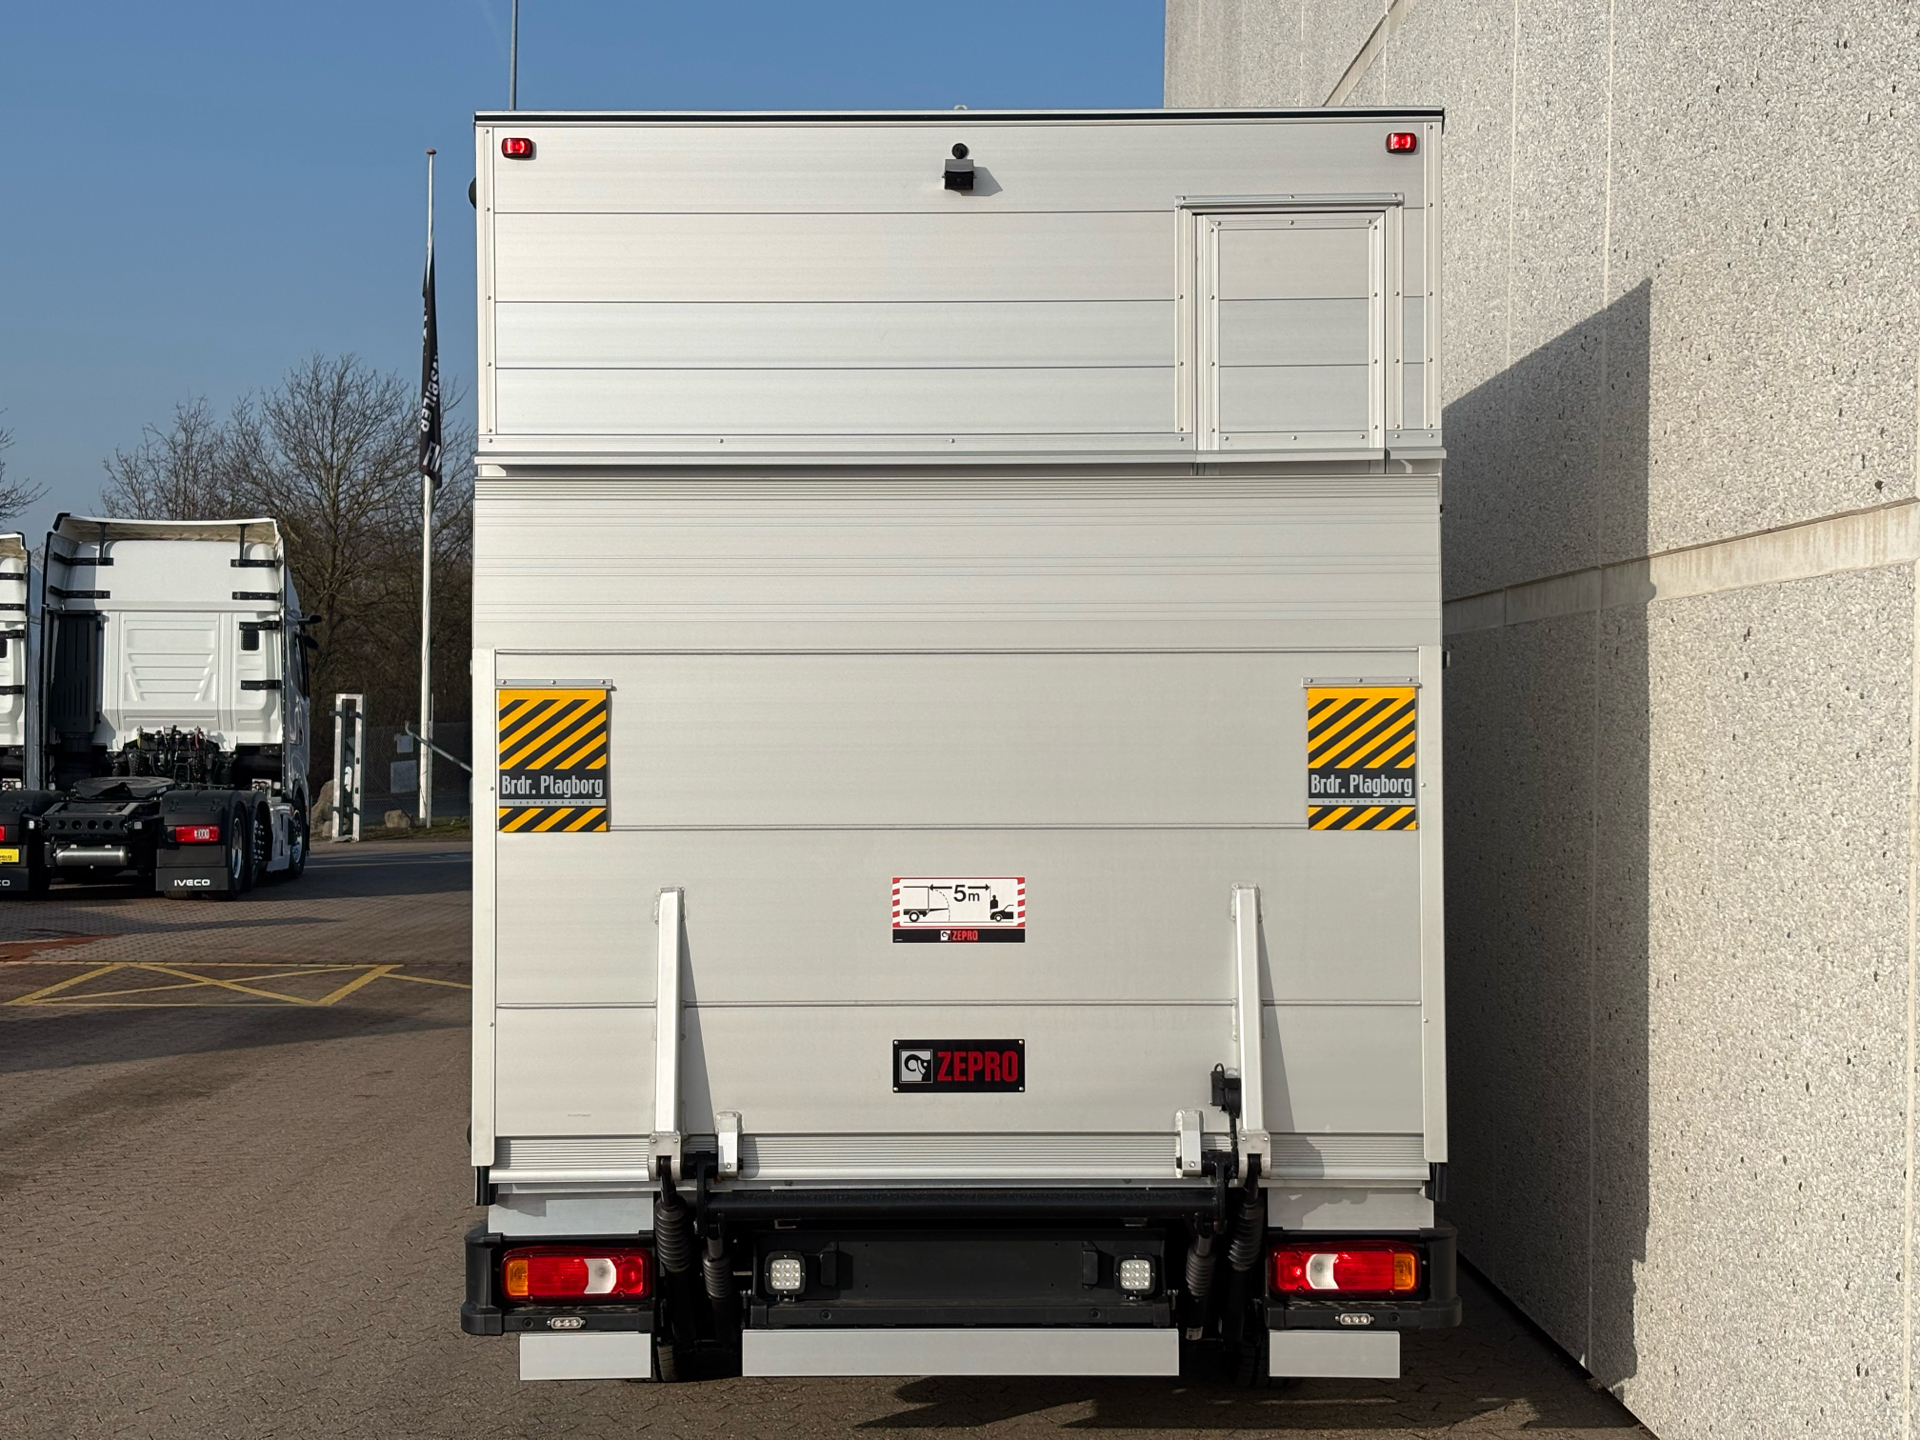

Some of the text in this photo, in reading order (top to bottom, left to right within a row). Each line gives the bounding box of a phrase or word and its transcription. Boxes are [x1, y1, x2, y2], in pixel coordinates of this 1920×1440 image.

[502, 775, 603, 798] Brdr. Plagborg
[1310, 774, 1412, 797] Brdr. Plagborg
[174, 879, 210, 887] IVECO
[952, 930, 979, 941] ZEPRO
[937, 1051, 1018, 1082] ZEPRO
